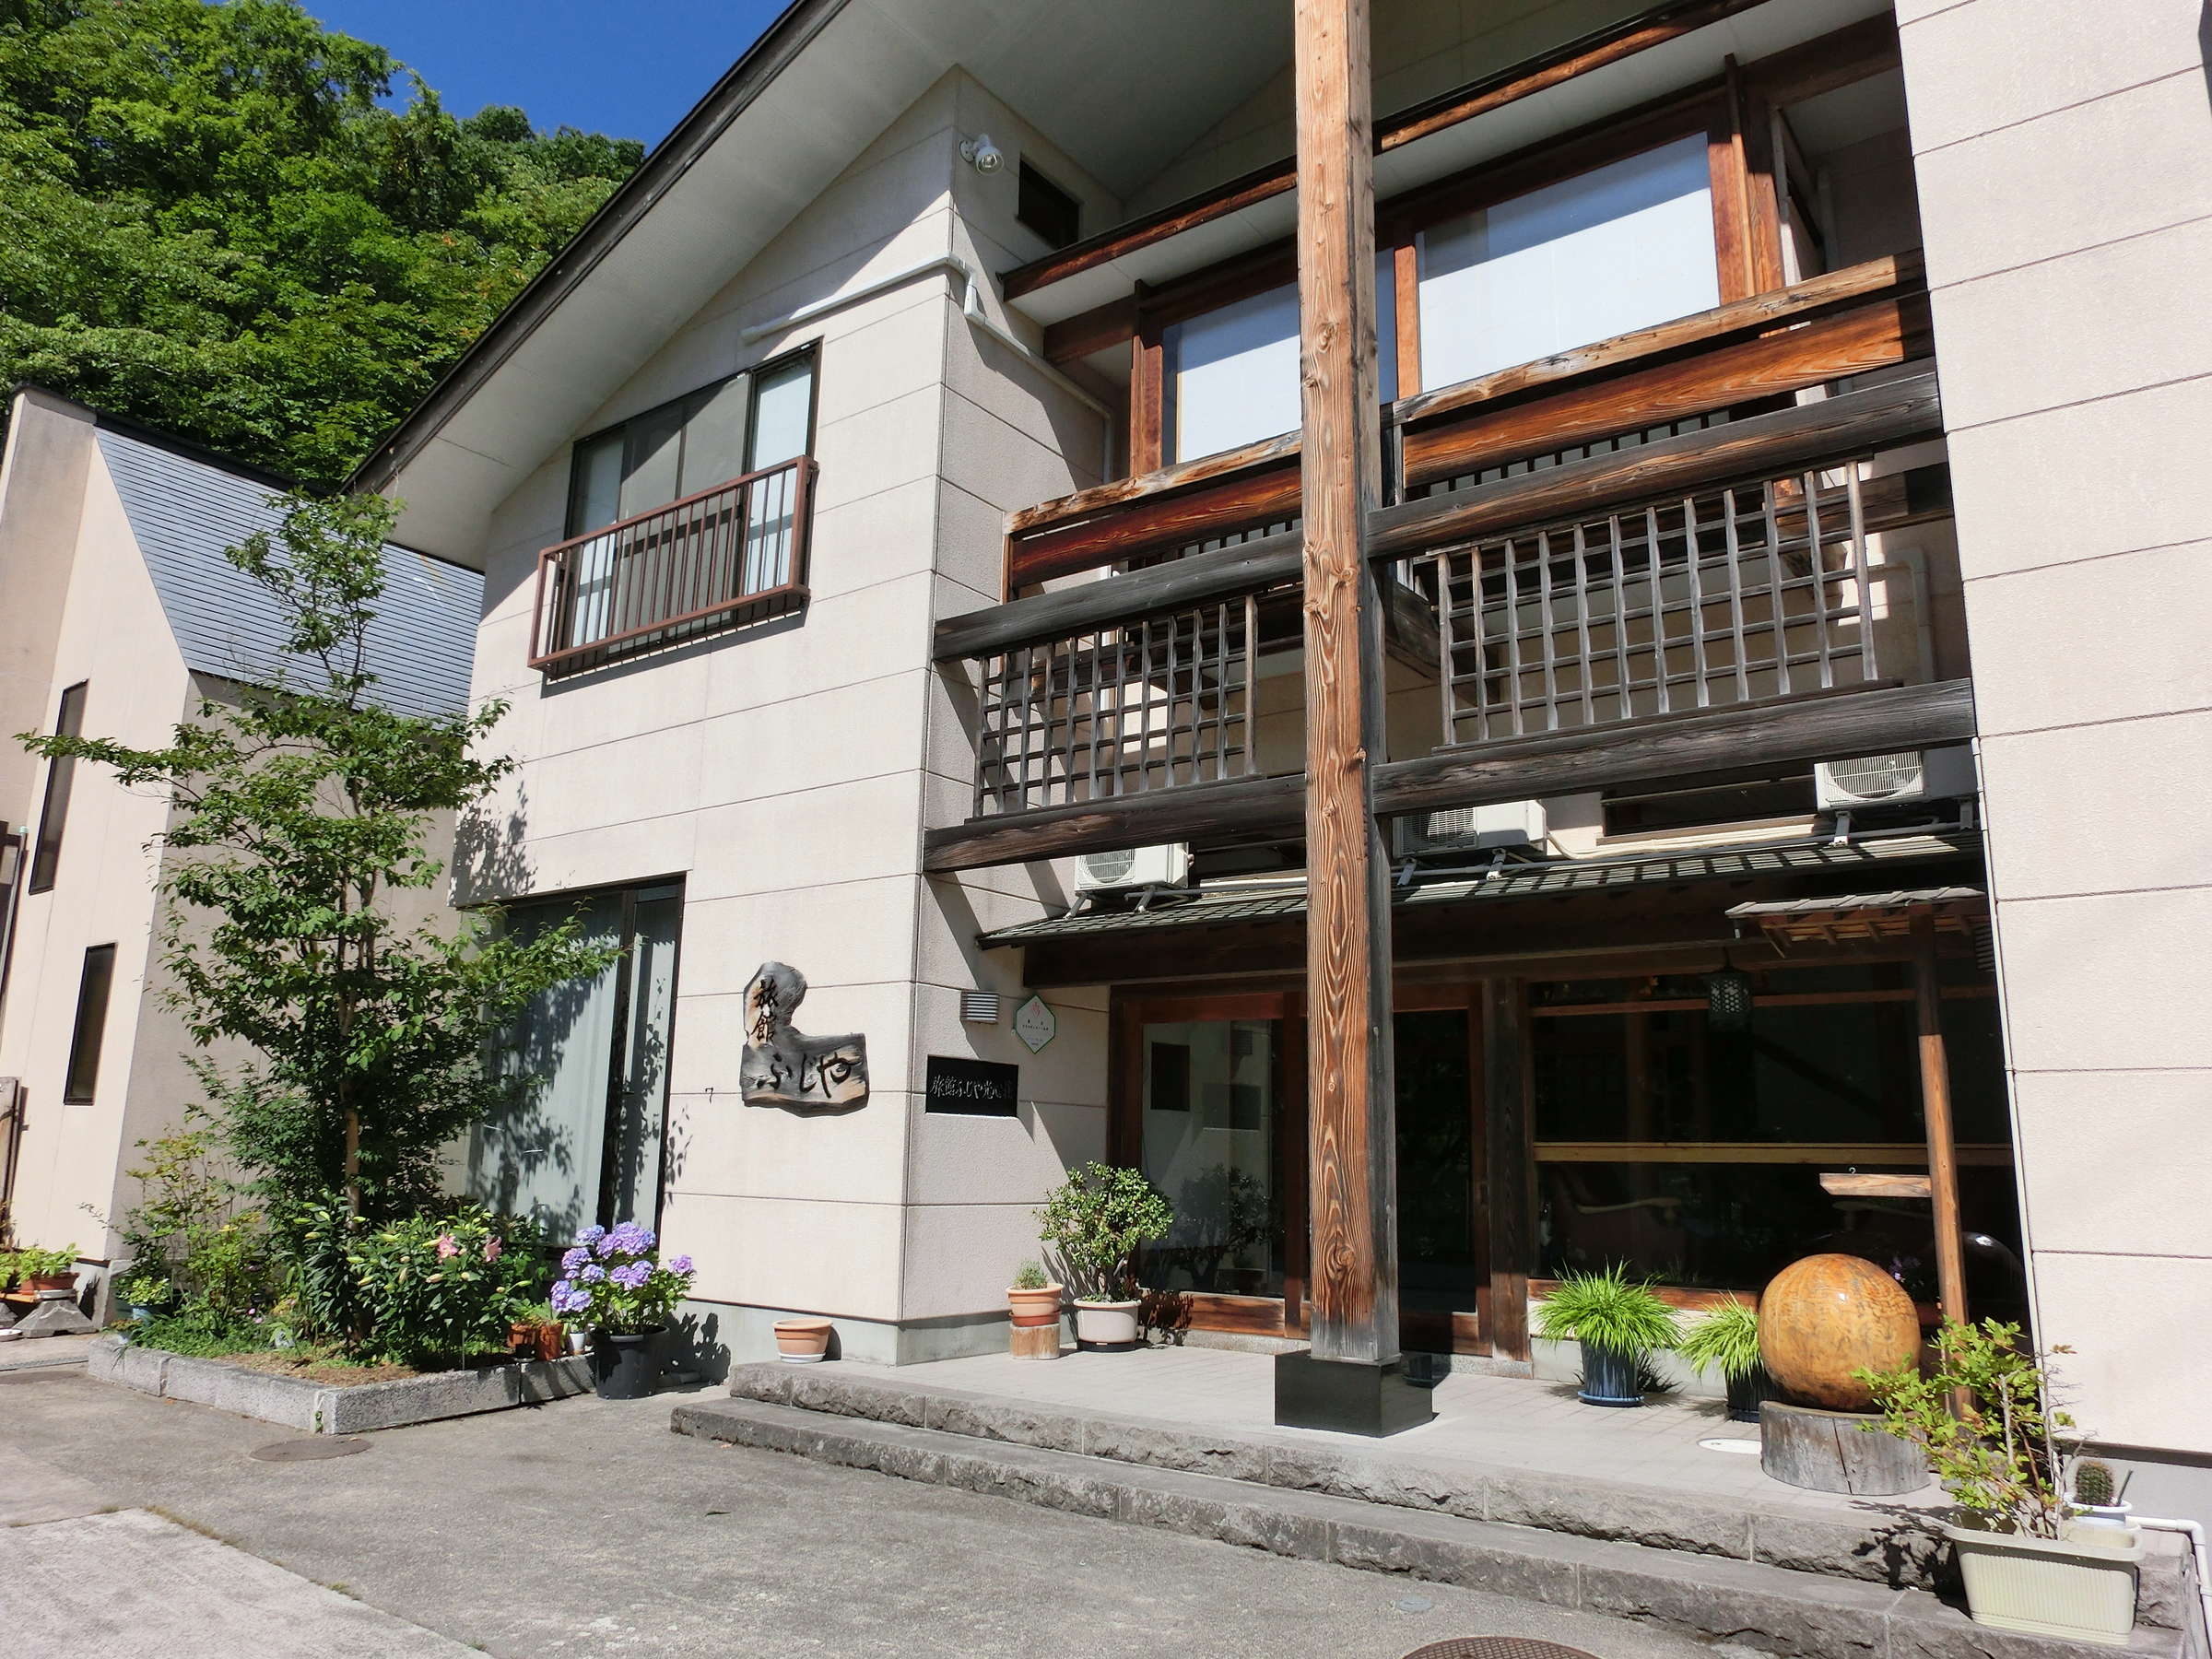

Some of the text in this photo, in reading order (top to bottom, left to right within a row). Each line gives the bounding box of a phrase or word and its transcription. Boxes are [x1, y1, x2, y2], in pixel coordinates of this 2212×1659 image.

[751, 975, 779, 1042] 旅館
[756, 1052, 862, 1099] ふじや
